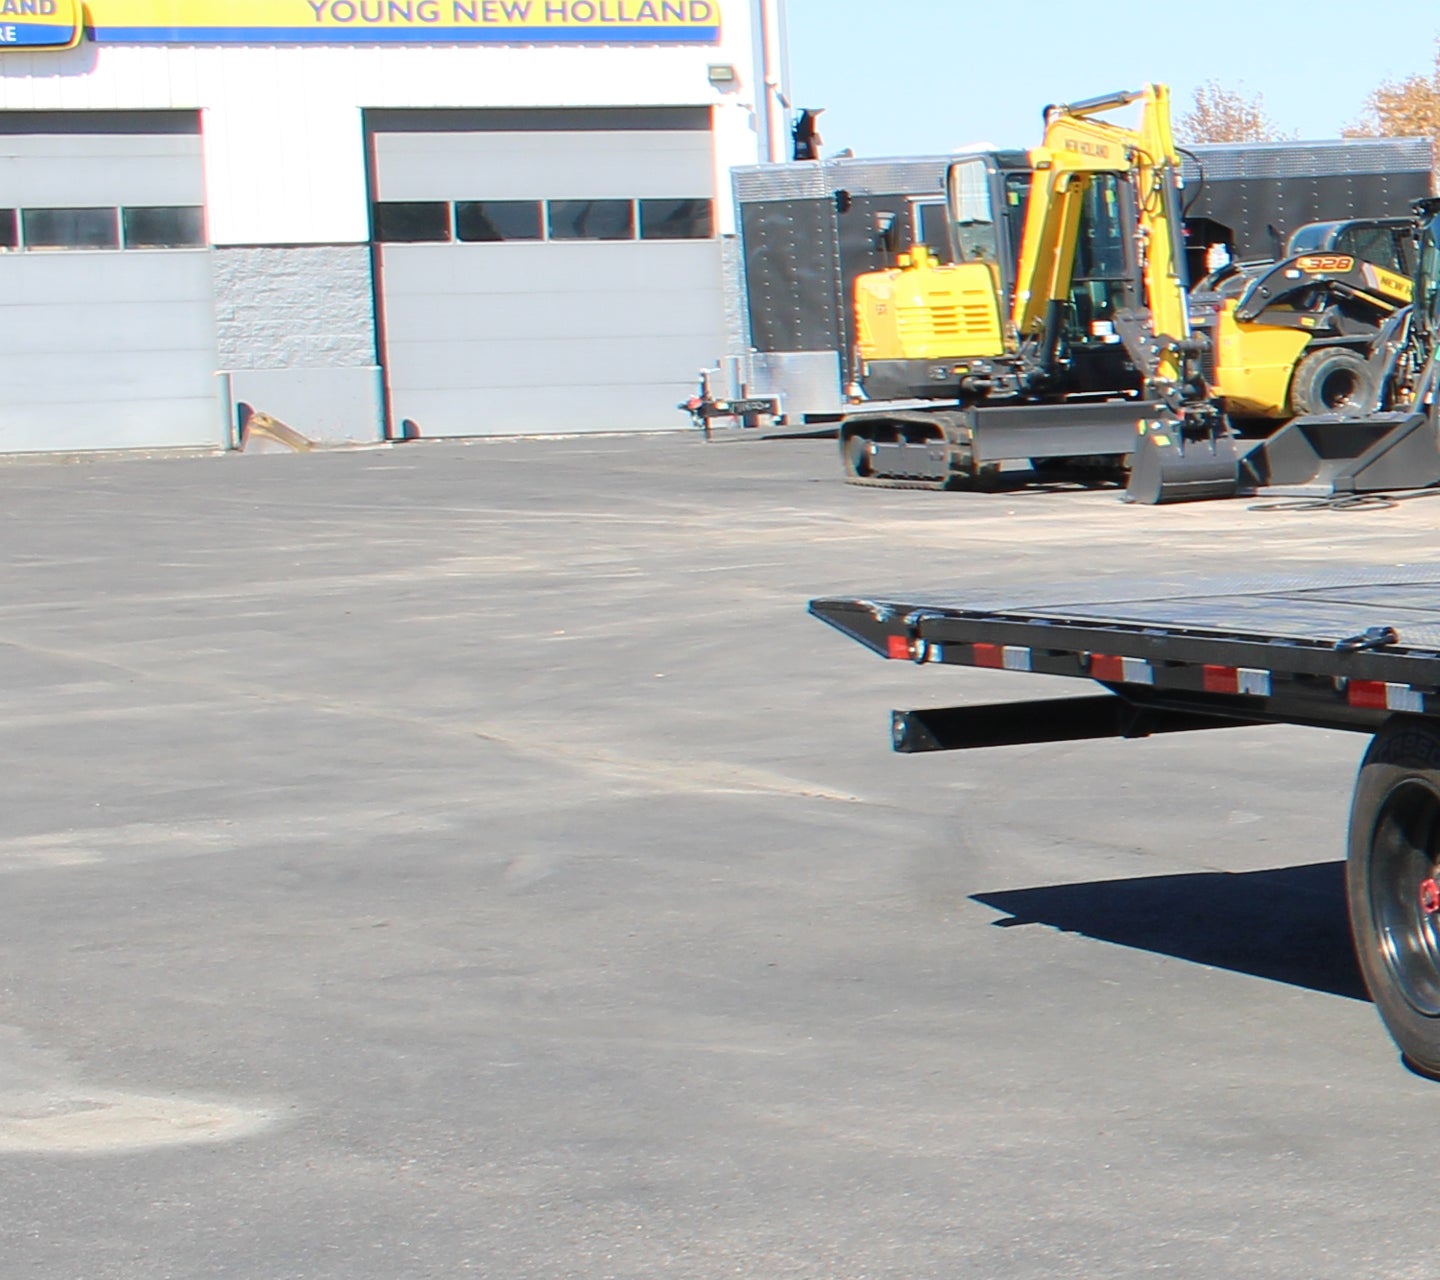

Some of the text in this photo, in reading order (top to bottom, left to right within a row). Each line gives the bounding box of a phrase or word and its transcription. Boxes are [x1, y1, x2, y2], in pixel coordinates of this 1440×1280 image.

[307, 0, 713, 22] YOUNG NEW HOLLAND
